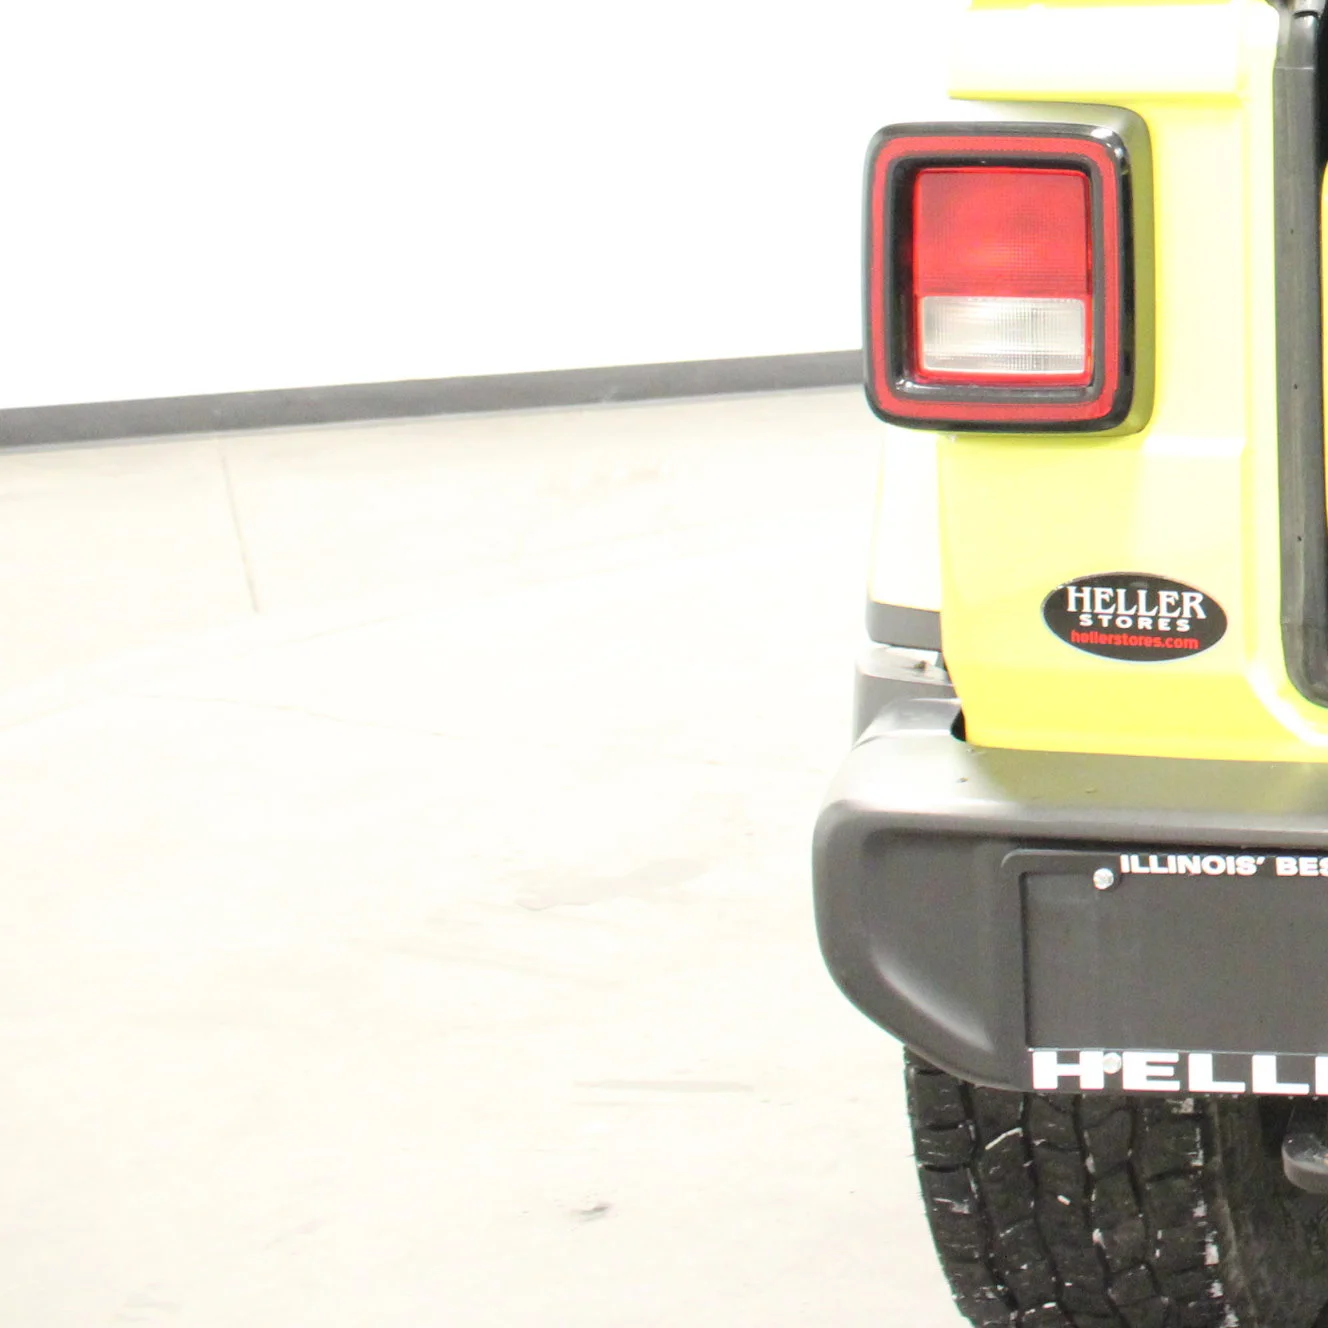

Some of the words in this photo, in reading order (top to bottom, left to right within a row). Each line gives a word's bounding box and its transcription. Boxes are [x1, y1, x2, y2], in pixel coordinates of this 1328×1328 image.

[1066, 585, 1207, 620] HELLER
[1079, 613, 1191, 633] STORES
[1070, 629, 1200, 651] hellerstores.com
